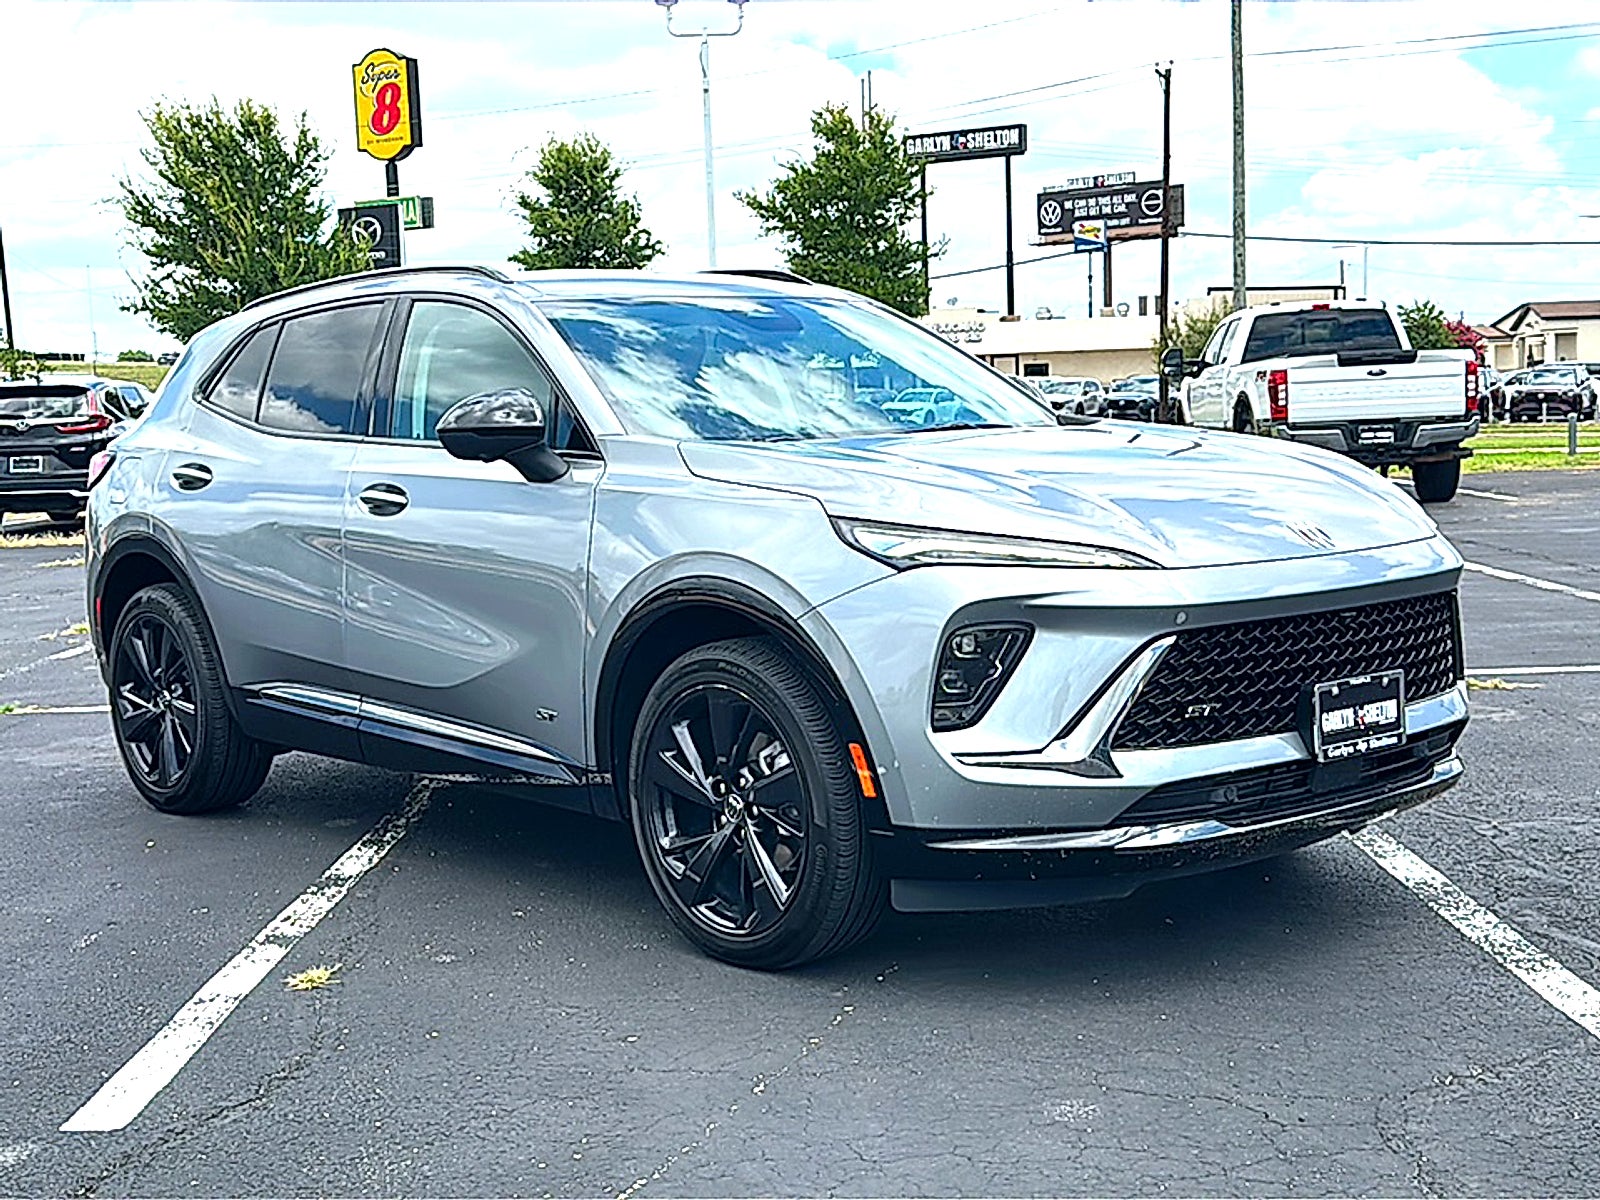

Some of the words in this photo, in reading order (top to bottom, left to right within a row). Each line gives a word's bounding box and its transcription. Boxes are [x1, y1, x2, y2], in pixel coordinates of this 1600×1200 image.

[361, 62, 401, 93] Super
[372, 82, 402, 136] 8
[906, 135, 951, 154] GARLYN
[966, 128, 1020, 149] SHELTON
[536, 707, 558, 721] ST
[1184, 703, 1222, 718] ST
[1363, 699, 1398, 724] SHELTON
